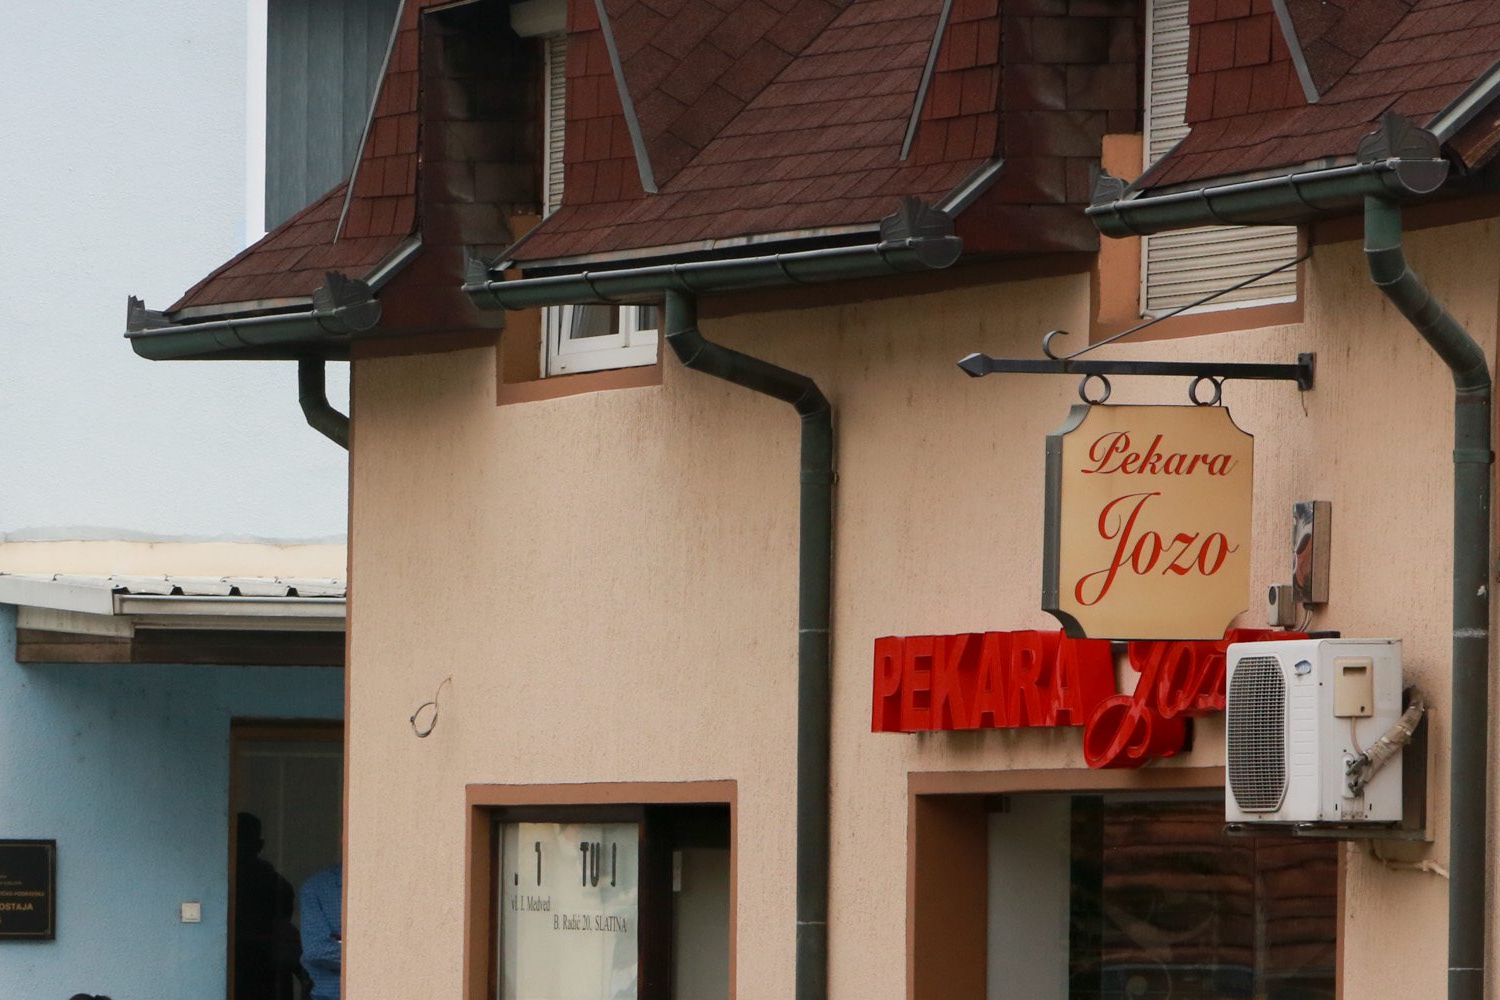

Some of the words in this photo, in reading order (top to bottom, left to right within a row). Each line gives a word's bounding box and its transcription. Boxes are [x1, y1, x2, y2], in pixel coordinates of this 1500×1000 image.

[1080, 430, 1238, 477] Pekara
[1074, 491, 1240, 606] Jozo
[871, 629, 1094, 734] PEKARA
[594, 915, 627, 933] SLATINA
